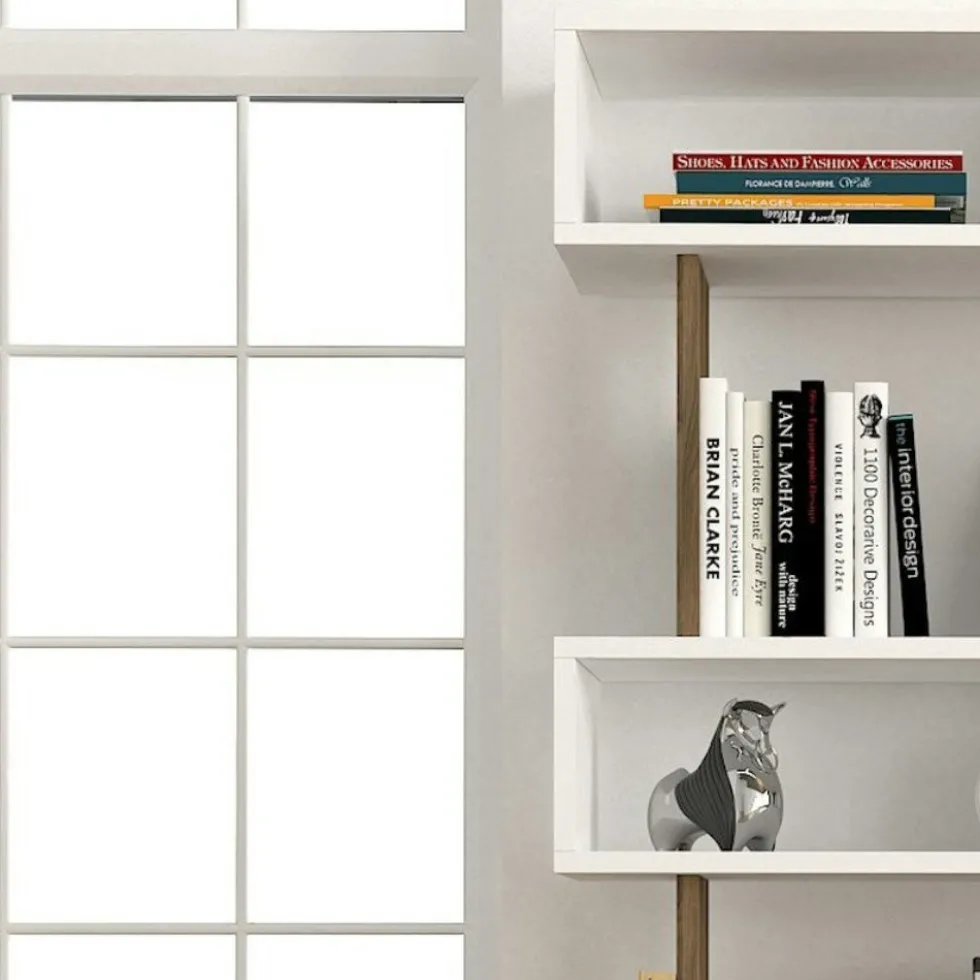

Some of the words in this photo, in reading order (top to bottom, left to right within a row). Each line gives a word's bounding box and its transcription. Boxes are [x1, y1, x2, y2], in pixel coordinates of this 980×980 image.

[672, 198, 722, 206] PRETTY
[724, 198, 793, 207] PACKAGES
[778, 401, 793, 437] JAN
[895, 422, 909, 445] the
[706, 438, 720, 499] BRIAN
[729, 447, 740, 488] pride
[752, 434, 764, 494] Charlotte
[778, 442, 793, 458] L.
[863, 447, 878, 483] 1100
[834, 443, 843, 501] VIOLENCE
[732, 492, 740, 520] and
[778, 462, 793, 544] McHARG
[706, 507, 720, 580] CLARKE
[729, 524, 740, 597] prejudice
[750, 542, 767, 577] Jane
[751, 578, 767, 607] Eyre
[778, 561, 788, 588] with
[787, 574, 799, 611] design
[778, 590, 788, 629] nature
[860, 569, 879, 627] Designs
